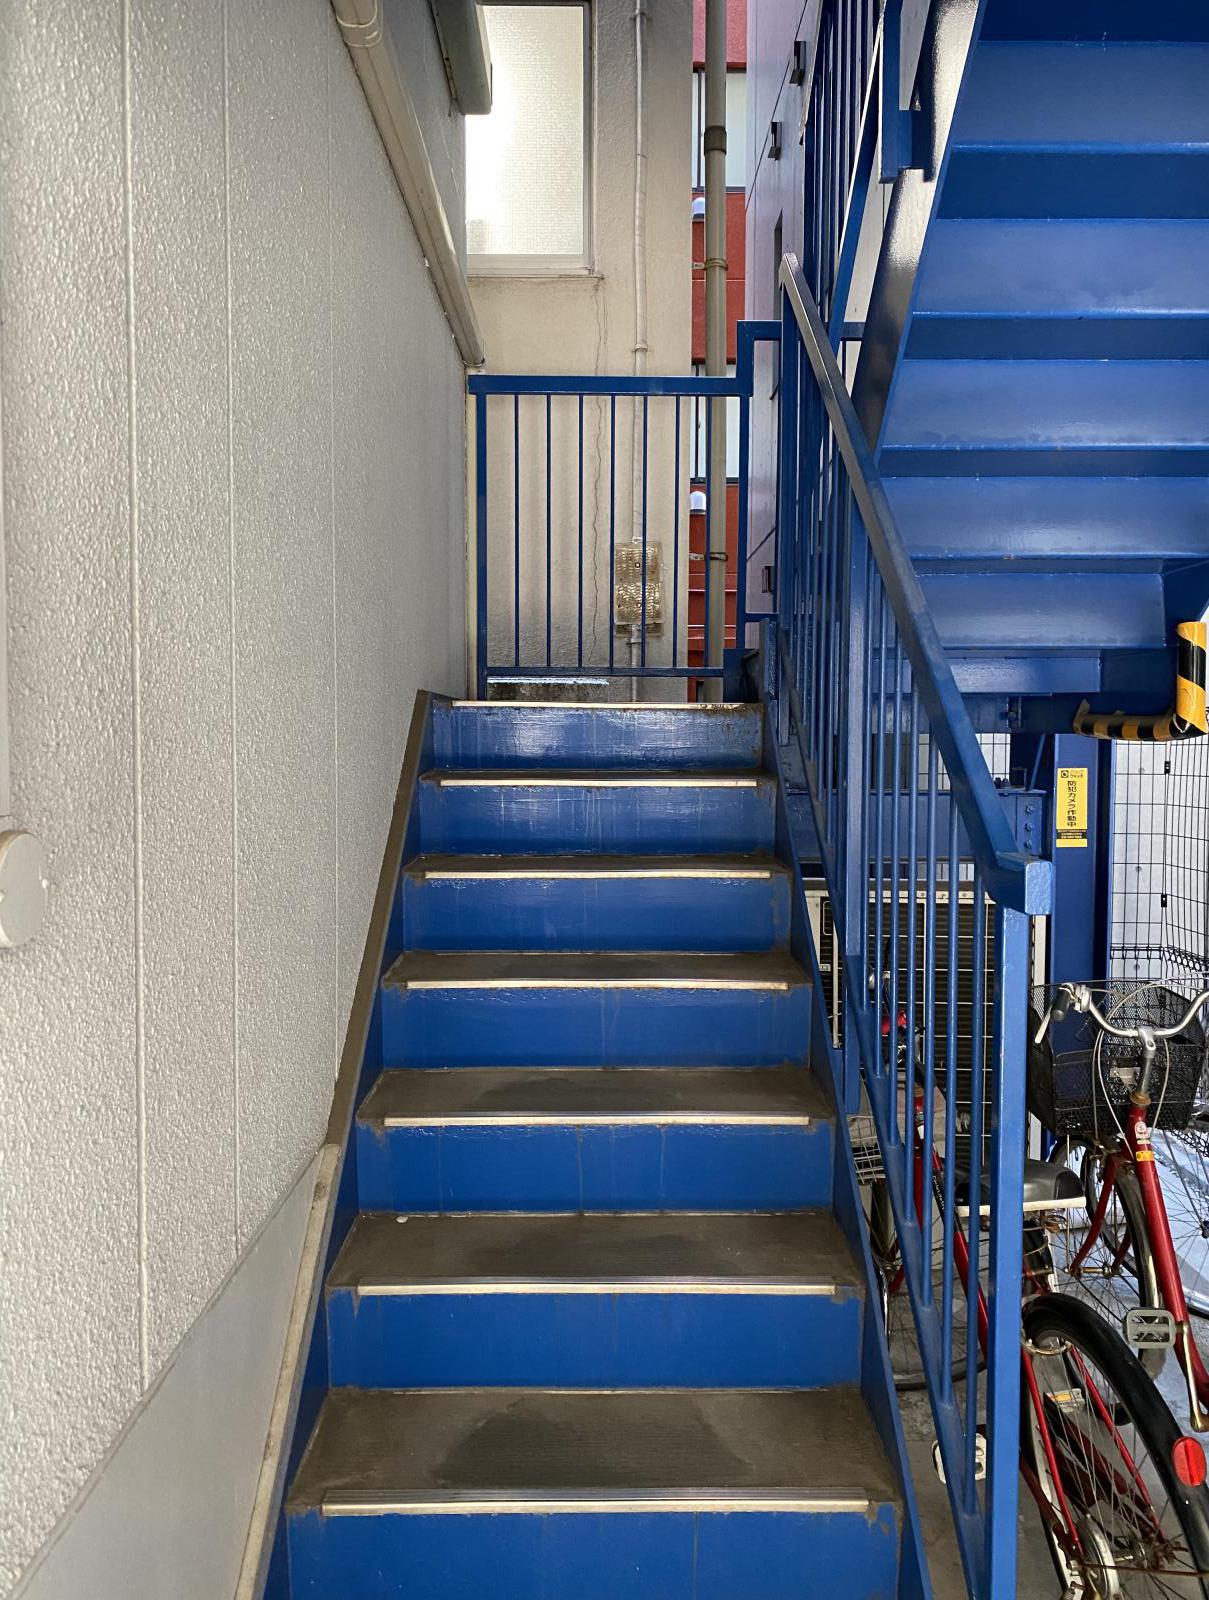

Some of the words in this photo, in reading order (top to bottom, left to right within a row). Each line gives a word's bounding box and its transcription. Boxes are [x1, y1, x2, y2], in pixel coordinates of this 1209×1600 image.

[1067, 780, 1077, 828] 防犯カメラ作動中
